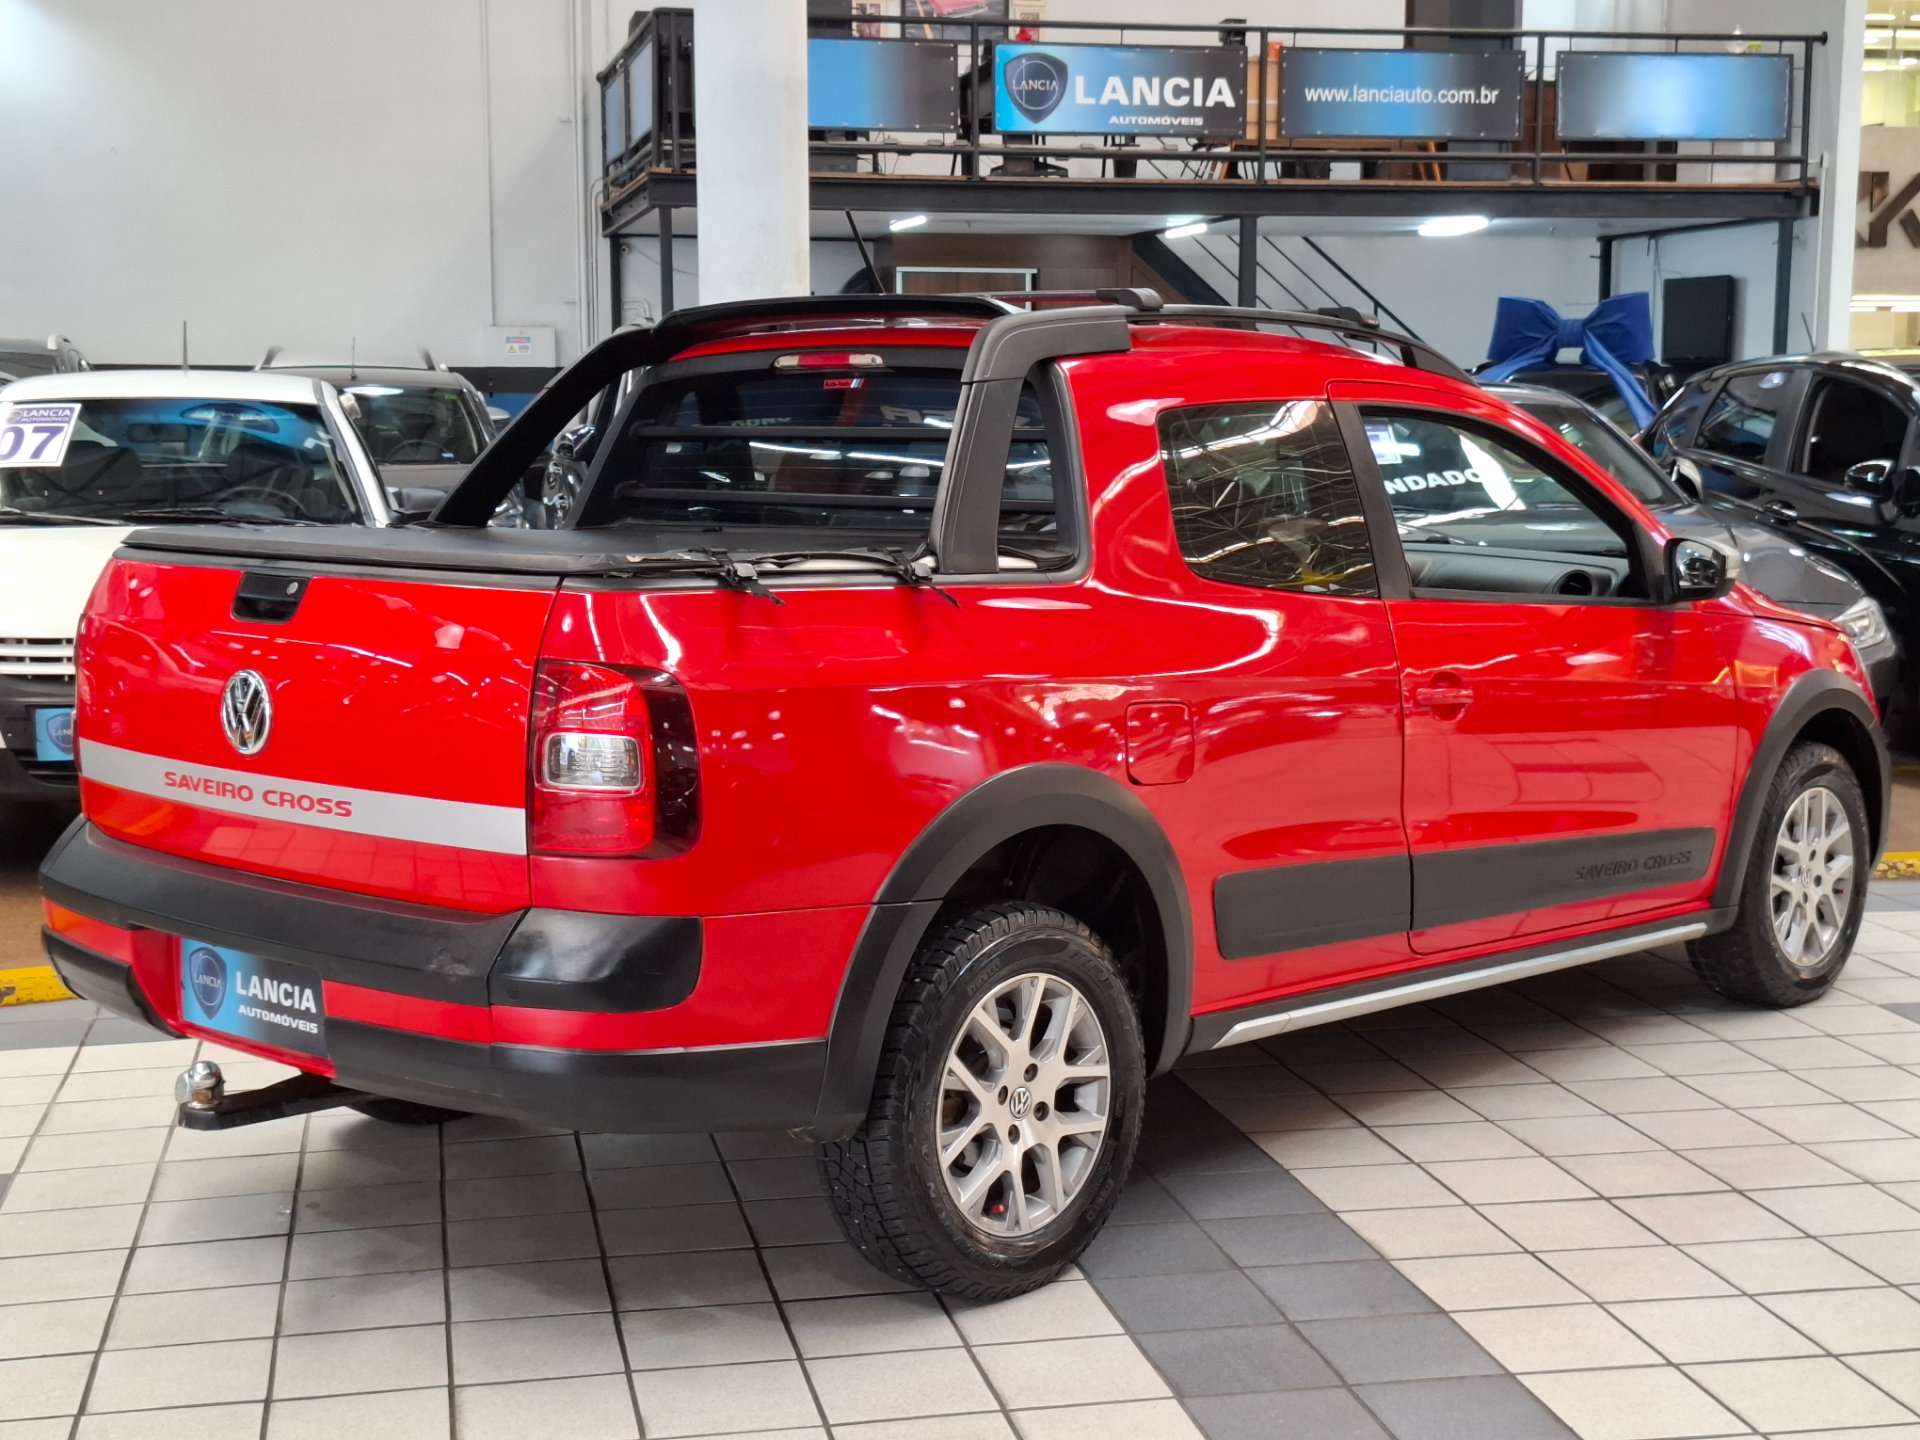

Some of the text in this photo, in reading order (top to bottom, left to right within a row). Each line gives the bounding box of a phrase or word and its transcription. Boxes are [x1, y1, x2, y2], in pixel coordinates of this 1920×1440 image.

[1012, 78, 1059, 91] LANCIA
[1074, 75, 1236, 107] LANCIA
[1304, 84, 1500, 104] www.lanciauto.com.br
[1108, 114, 1204, 126] AUTOMÓVEIS
[23, 408, 71, 417] LANCIA
[163, 771, 353, 818] SAVEIRO CROSS
[1575, 850, 1692, 880] SAVEIRO CROSS
[194, 973, 222, 988] LANCIA
[235, 971, 317, 1014] LANCIA
[238, 1004, 319, 1034] AUTOMÓVEIS
